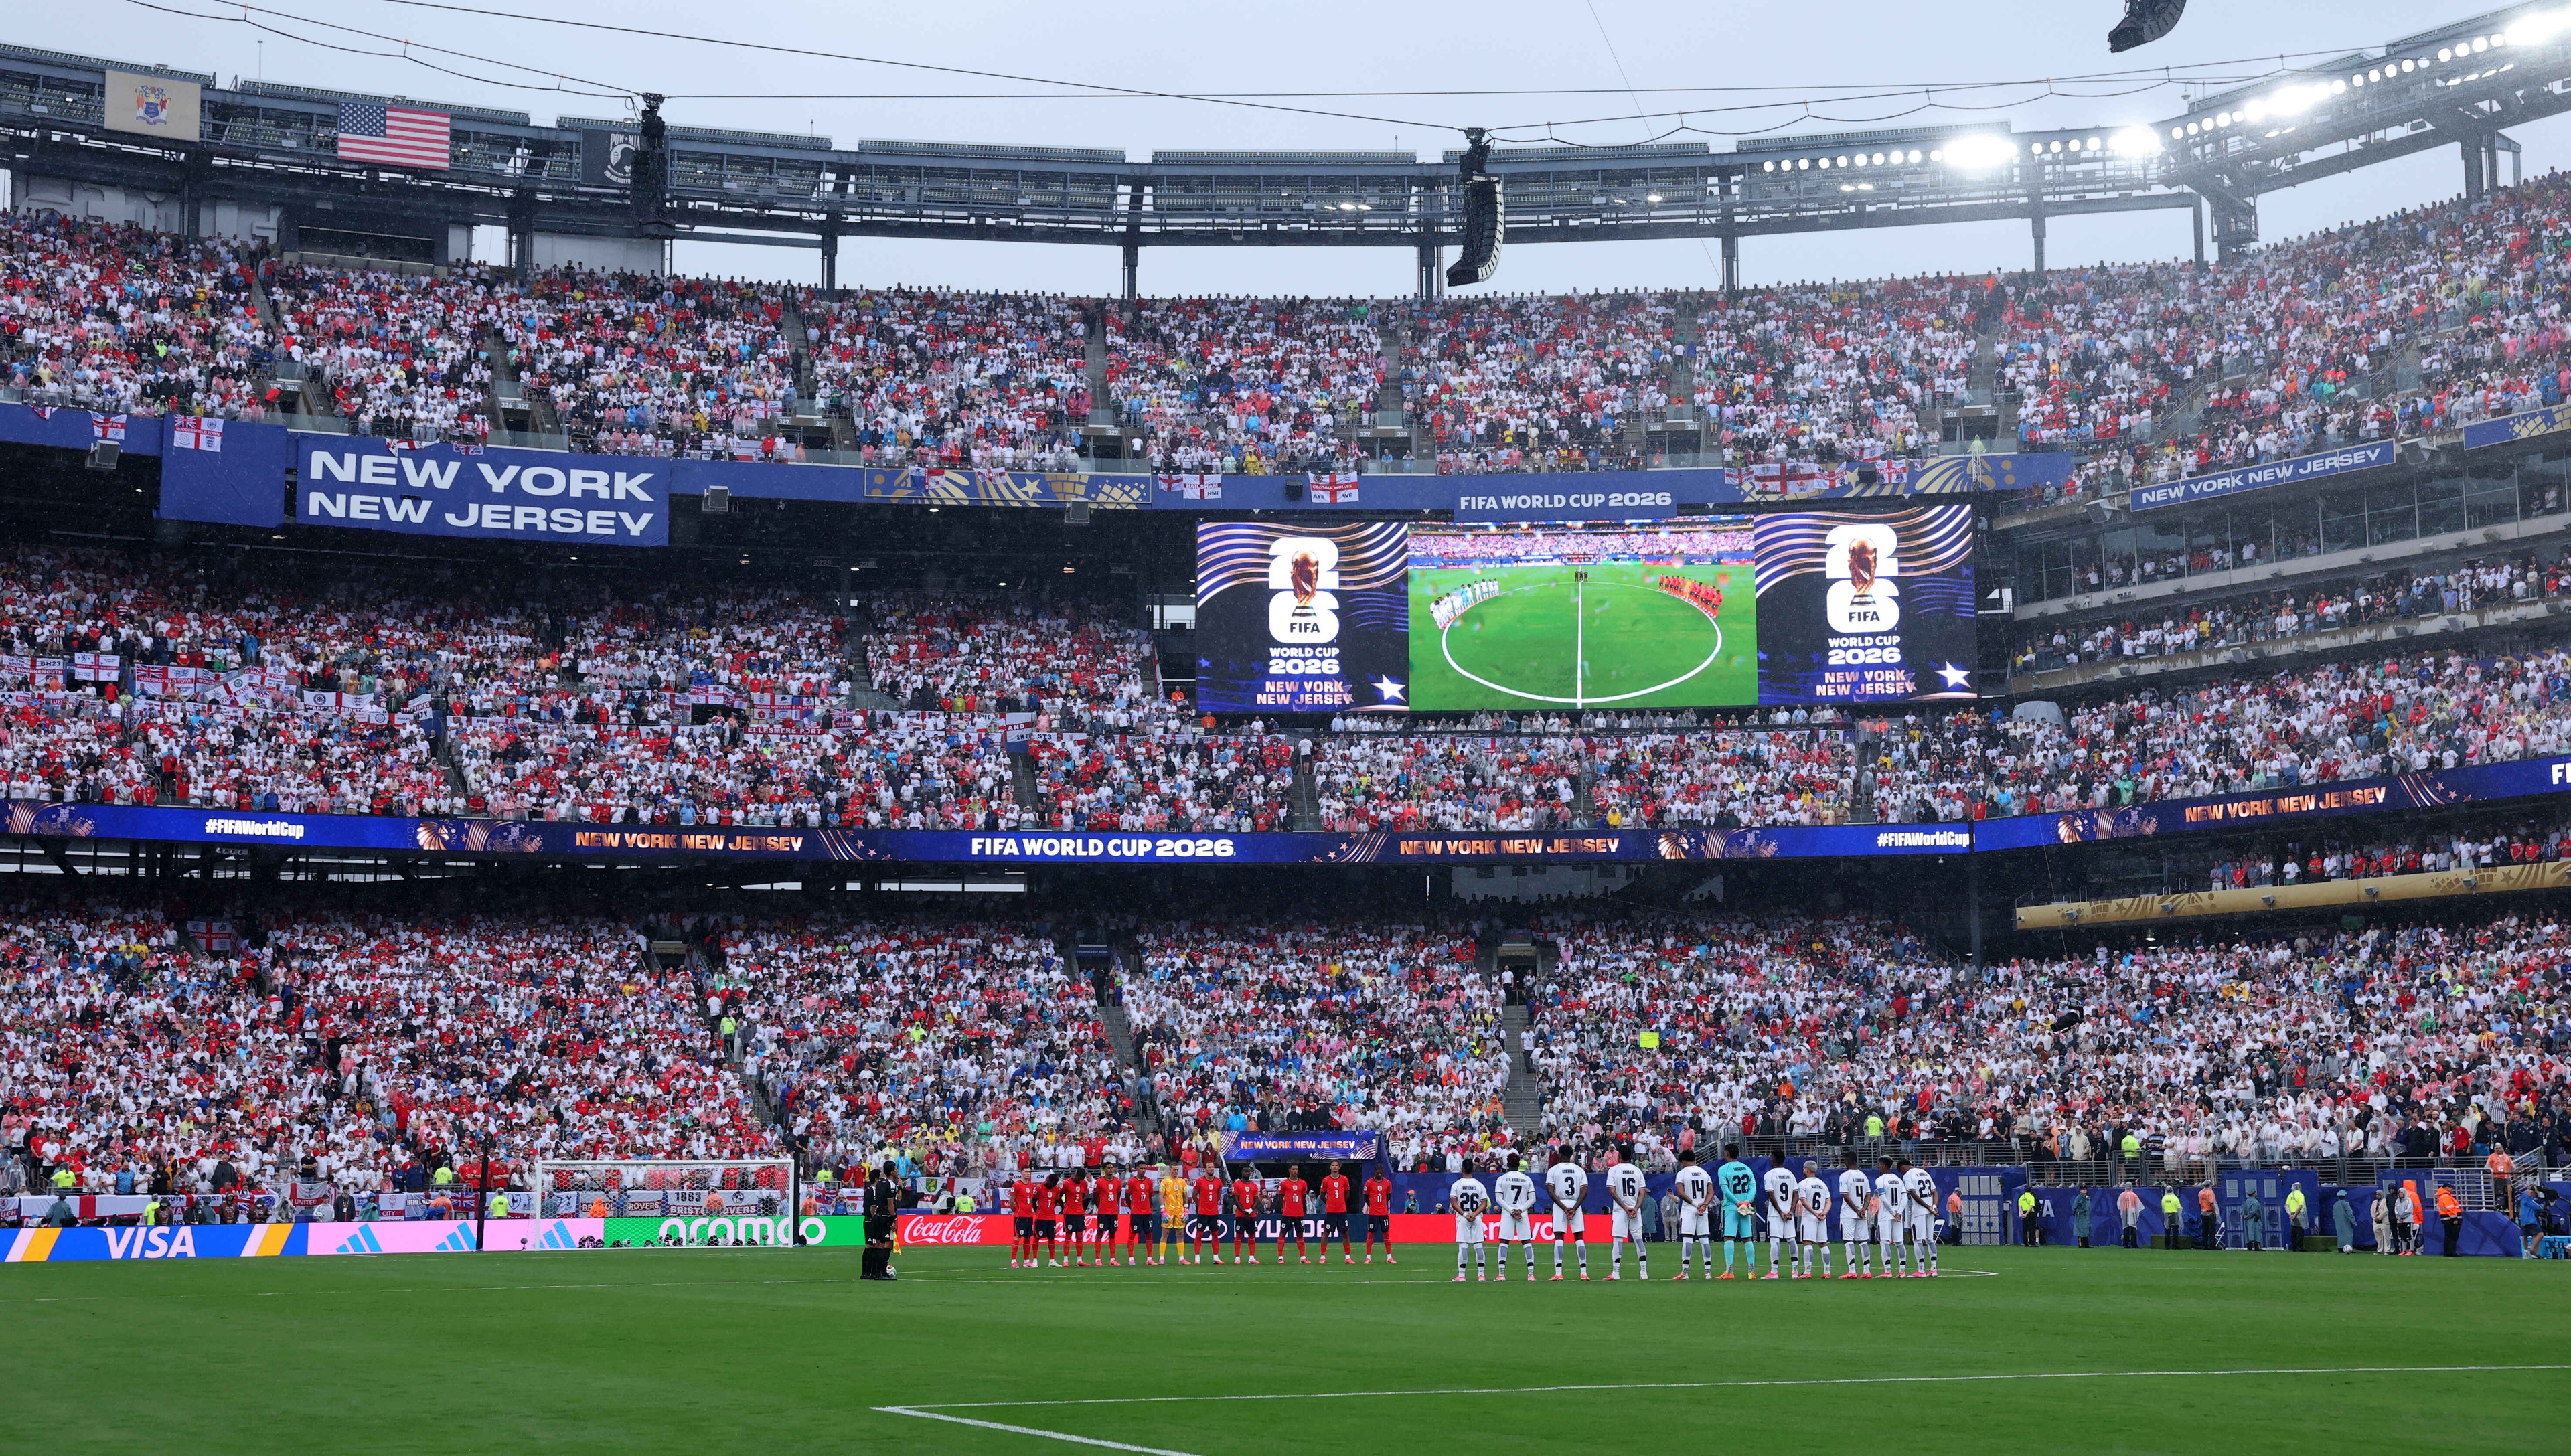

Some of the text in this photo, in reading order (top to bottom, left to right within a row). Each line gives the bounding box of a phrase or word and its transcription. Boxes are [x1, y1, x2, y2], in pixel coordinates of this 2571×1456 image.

[610, 133, 641, 151] POW MIA
[175, 427, 207, 435] HUDDERSFIELD
[310, 450, 655, 501] NEW YORK
[2142, 447, 2381, 504] NEW YORK NEW JERSEY
[1460, 492, 1671, 511] FIFA WORLD CUP 2026
[309, 491, 654, 536] NEW JERSEY
[1848, 611, 1881, 623] FIFA
[1290, 622, 1320, 633] FIFA
[1828, 635, 1901, 647] WORLD CUP
[1269, 647, 1340, 657] WORLD CUP
[1828, 647, 1901, 665] 2026
[17, 667, 63, 675] BOURNEMOUTH
[1269, 659, 1340, 675] 2026
[1824, 669, 1905, 683] NEW YORK
[1265, 681, 1344, 693] NEW YORK
[1816, 681, 1914, 696] NEW JERSEY
[1256, 692, 1352, 705] NEW JERSEY
[2551, 762, 2571, 785] FI
[2185, 786, 2387, 823] NEW YORK NEW JERSEY
[205, 819, 305, 840] #FIFAWorldCup
[575, 831, 803, 852] NEW YORK NEW JERSEY
[971, 837, 1234, 857] FIFA WORLD CUP 2026
[1399, 838, 1620, 855] NEW YORK NEW JERSEY
[1877, 831, 1976, 848] #FIFAWorldCup
[1240, 1140, 1356, 1150] NEW YORK NEW JERSEY
[1564, 1176, 1575, 1196] 3
[1622, 1177, 1636, 1196] 16
[1691, 1180, 1705, 1199] 14
[1732, 1174, 1749, 1194] 22
[1780, 1182, 1788, 1202] 9
[1918, 1179, 1932, 1198] 23
[674, 1192, 701, 1202] 1883
[1209, 1194, 1213, 1202] 9
[1460, 1192, 1480, 1212] 26
[1510, 1184, 1523, 1204] 7
[1812, 1192, 1821, 1210] 6
[1855, 1185, 1863, 1204] 4
[1891, 1187, 1898, 1206] 11
[628, 1202, 660, 1210] ROVERS
[904, 1215, 987, 1244] Coca-Cola
[1383, 1218, 1389, 1226] 11
[659, 1217, 826, 1247] aramco
[97, 1226, 196, 1259] VISA
